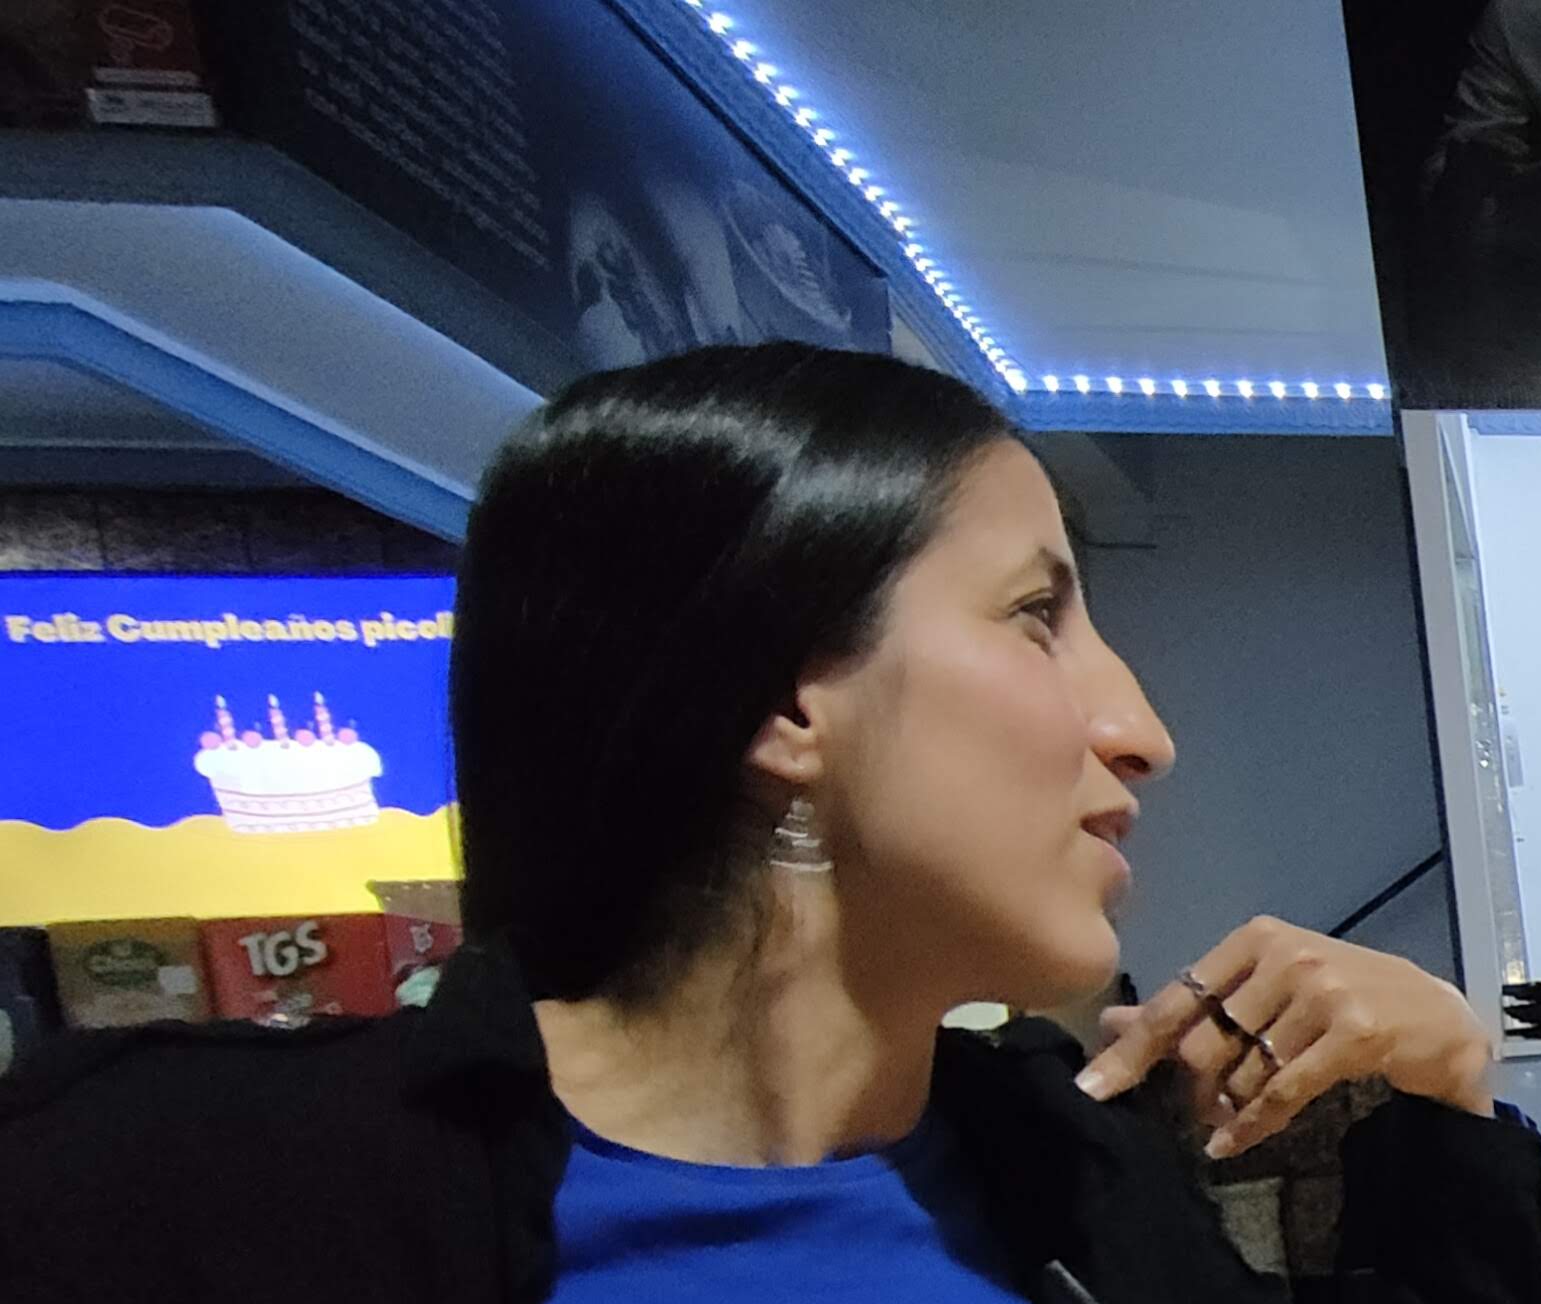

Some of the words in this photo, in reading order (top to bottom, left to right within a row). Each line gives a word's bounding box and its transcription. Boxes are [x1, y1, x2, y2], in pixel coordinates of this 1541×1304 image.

[4, 612, 106, 644] Feliz
[106, 612, 358, 649] Cumpleaños
[238, 919, 328, 977] TGS
